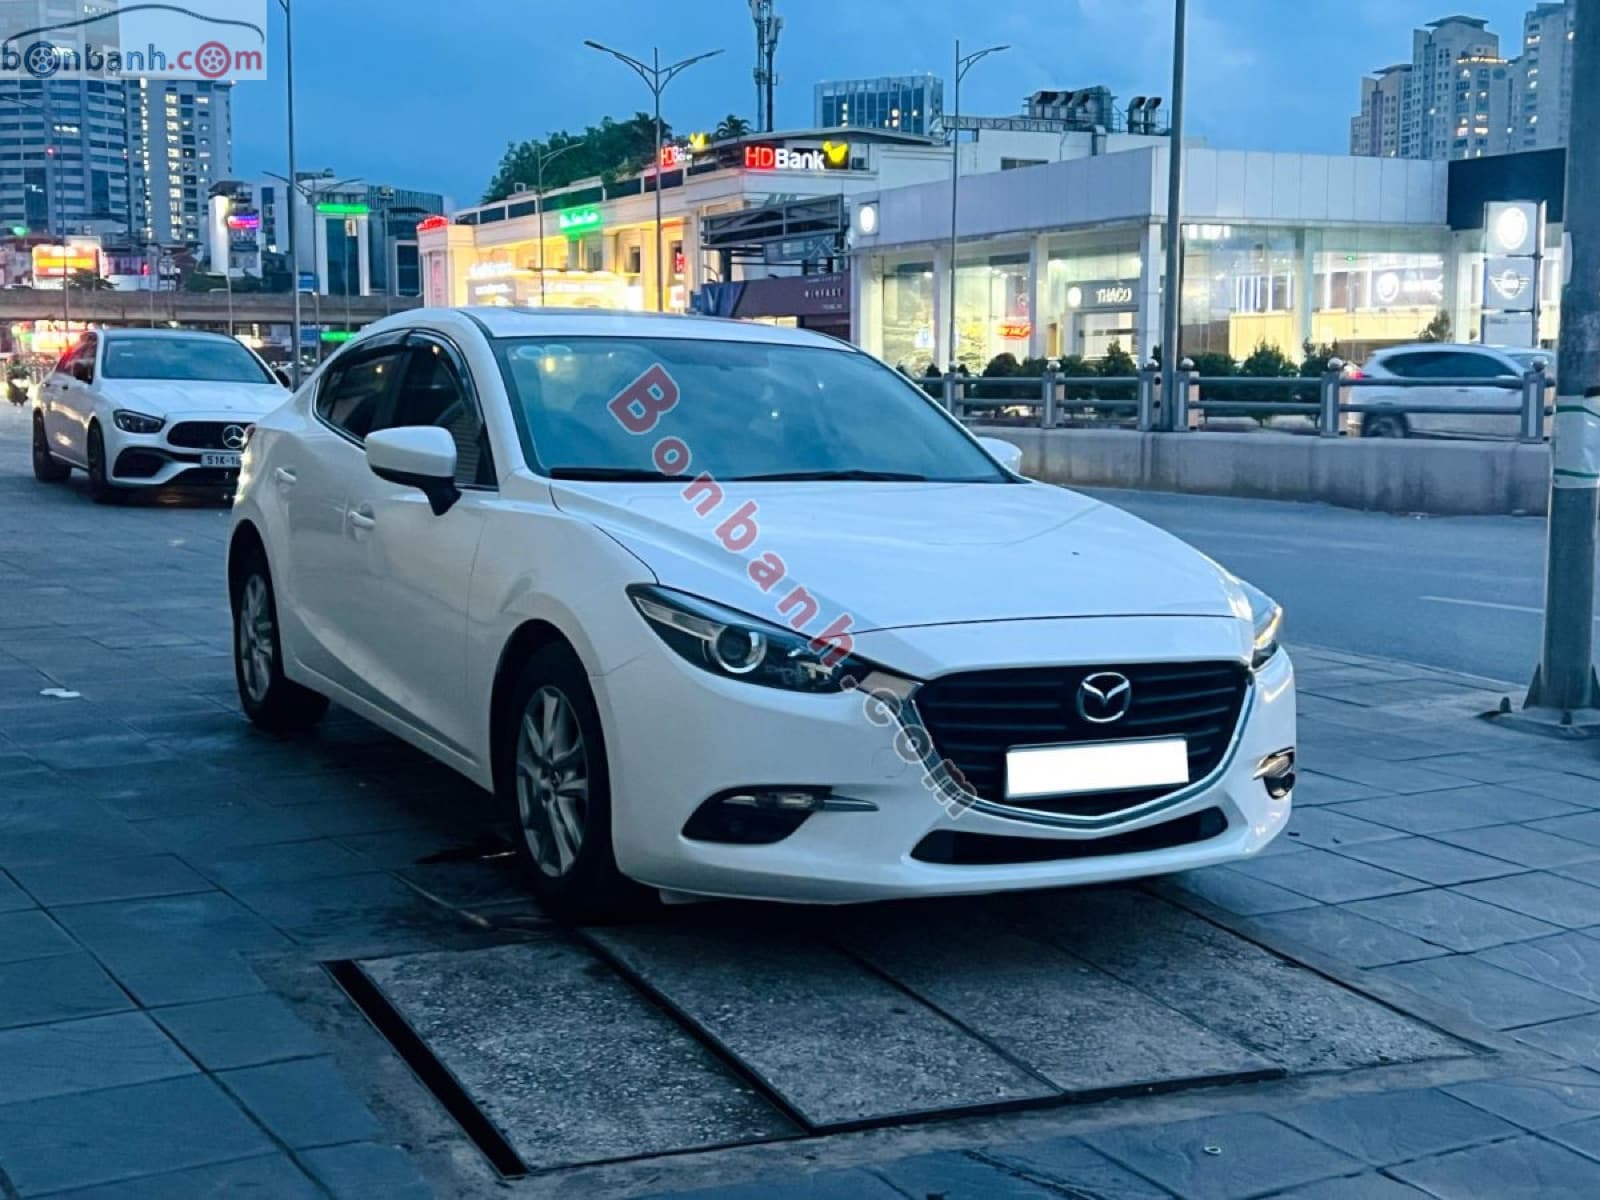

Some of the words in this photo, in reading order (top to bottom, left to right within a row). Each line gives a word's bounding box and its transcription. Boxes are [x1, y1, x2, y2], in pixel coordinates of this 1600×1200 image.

[744, 146, 825, 170] HDBank
[1095, 287, 1132, 303] THACO
[207, 454, 240, 465] 51K-1
